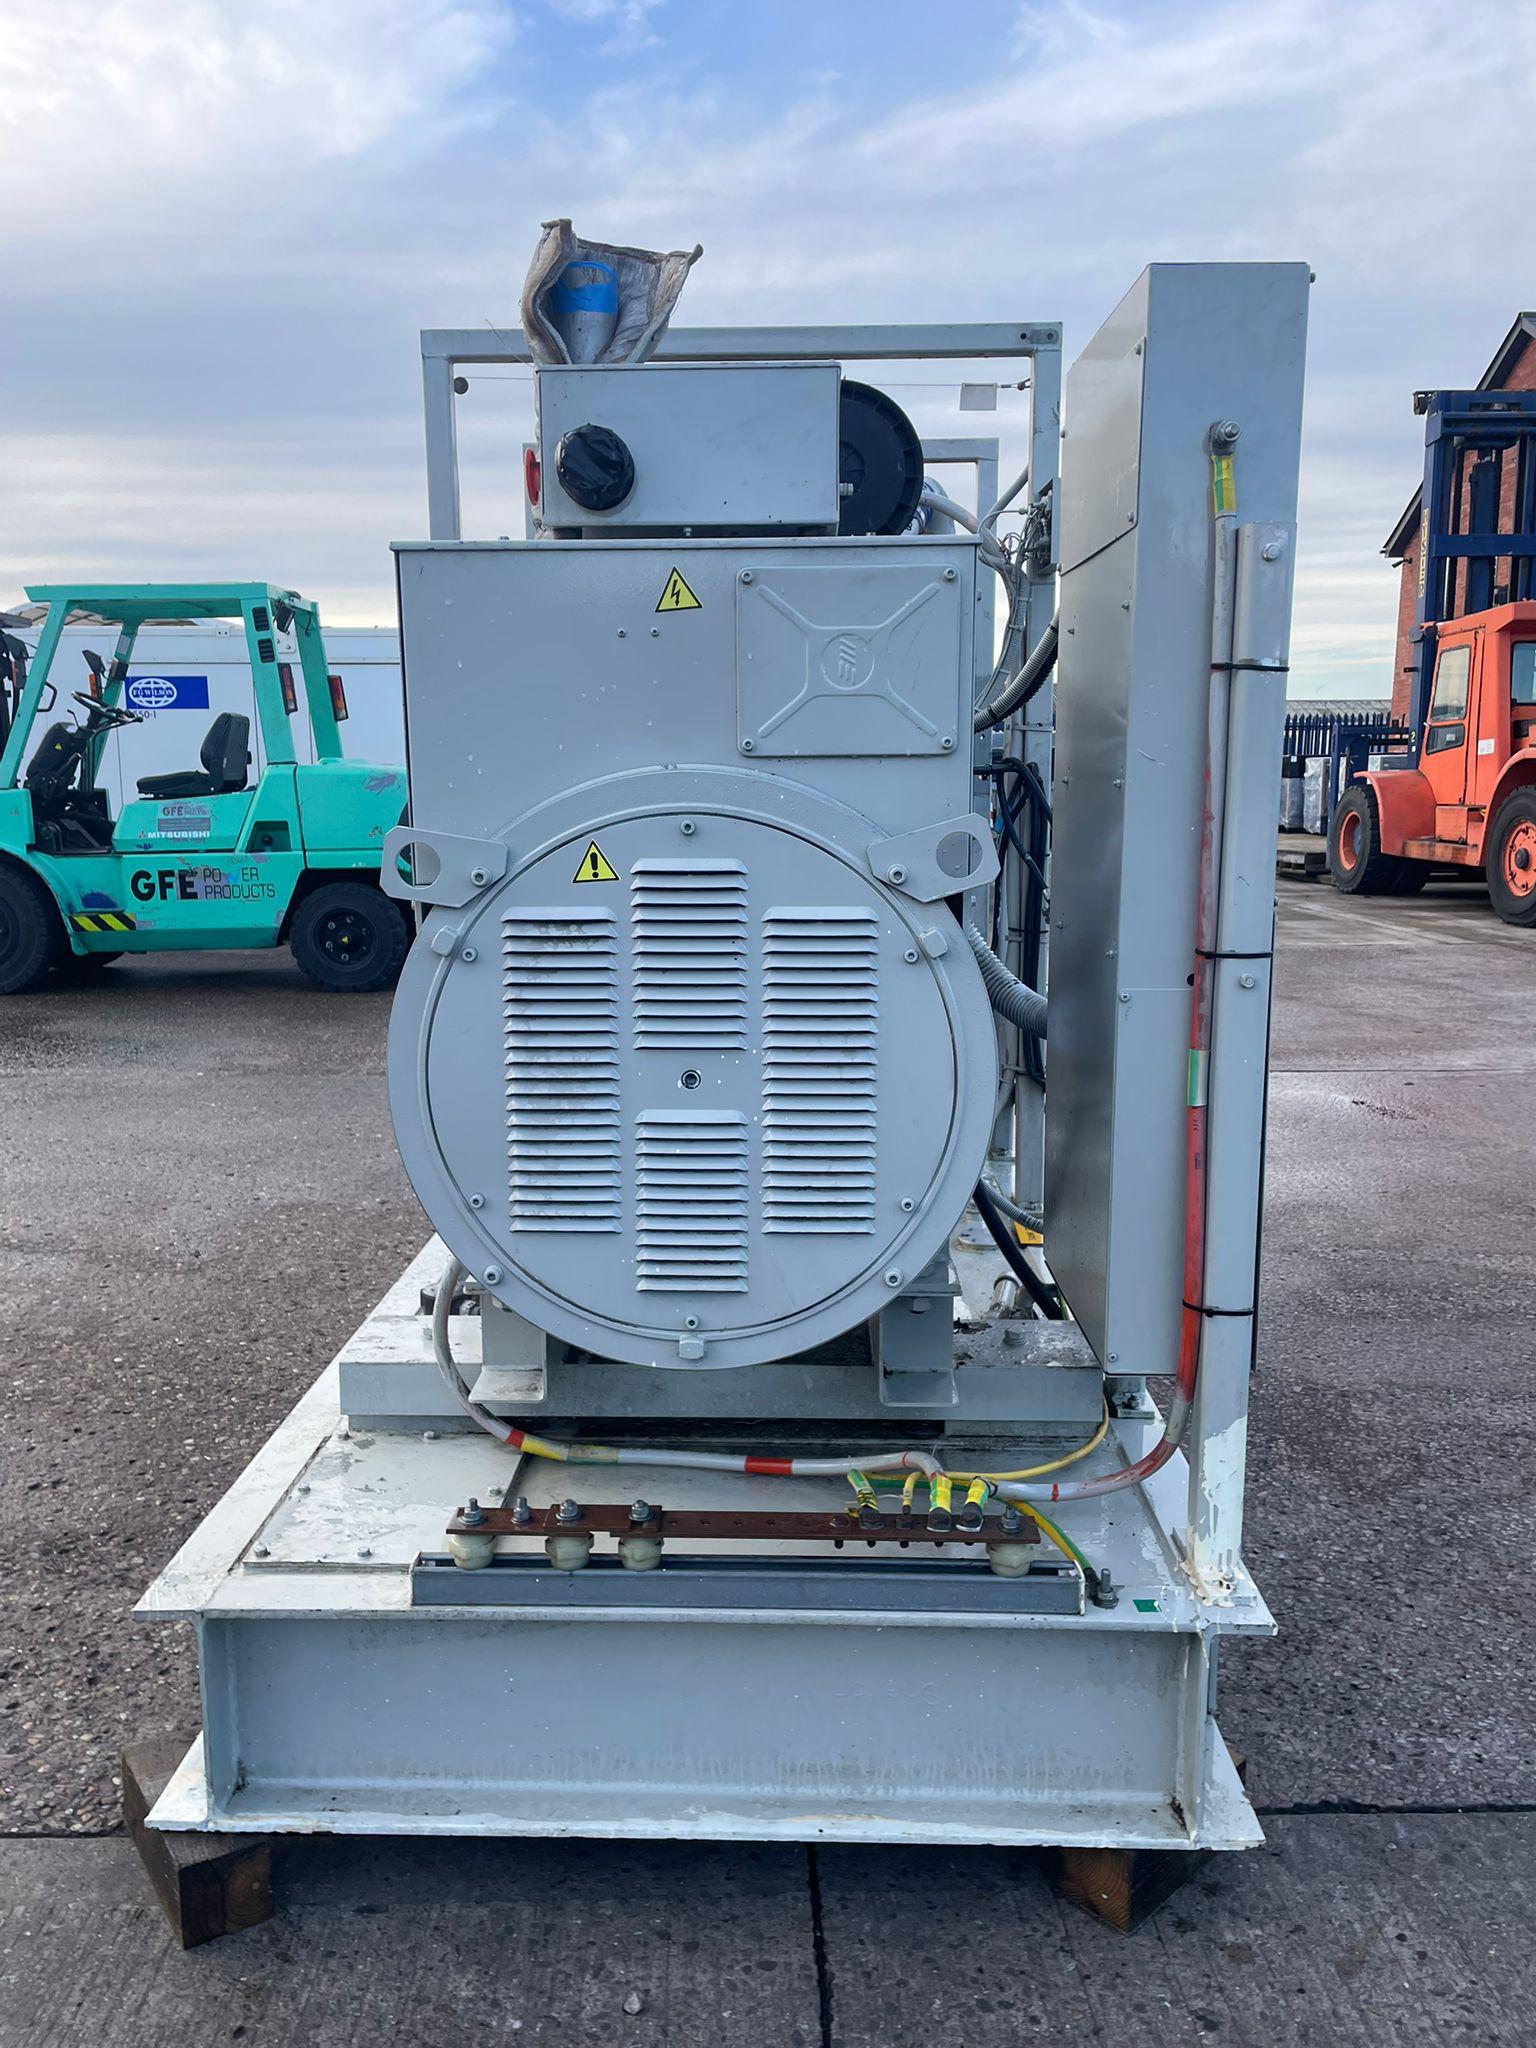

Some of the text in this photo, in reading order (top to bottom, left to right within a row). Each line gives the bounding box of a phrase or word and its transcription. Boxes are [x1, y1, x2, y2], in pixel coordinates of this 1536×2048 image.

[133, 687, 173, 697] FG WILSON
[163, 806, 183, 816] GFE
[131, 869, 198, 901] GFE
[204, 883, 276, 900] PRODUCTS
